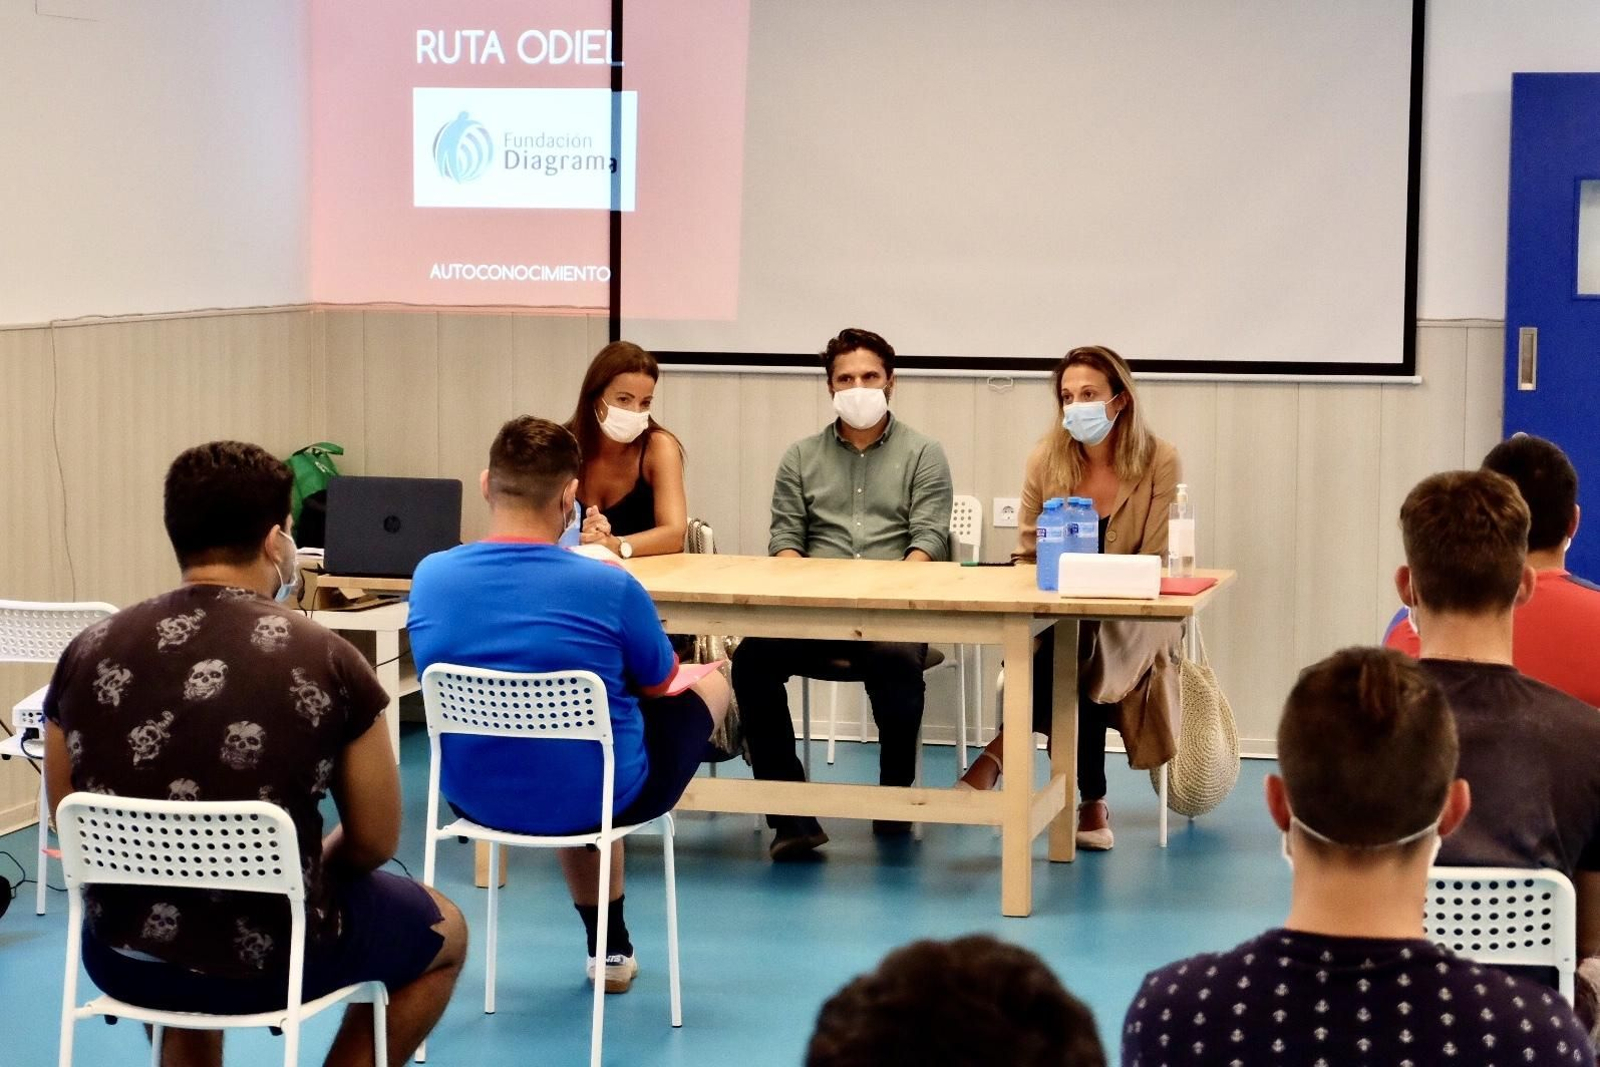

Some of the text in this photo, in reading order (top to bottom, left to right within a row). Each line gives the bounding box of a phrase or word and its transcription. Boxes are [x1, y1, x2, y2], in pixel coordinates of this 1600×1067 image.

[416, 29, 625, 67] RUTA ODIEL
[503, 131, 593, 149] Fundación
[504, 149, 618, 176] Diagrama
[429, 262, 612, 282] AUTOCONOCIMIENTO
